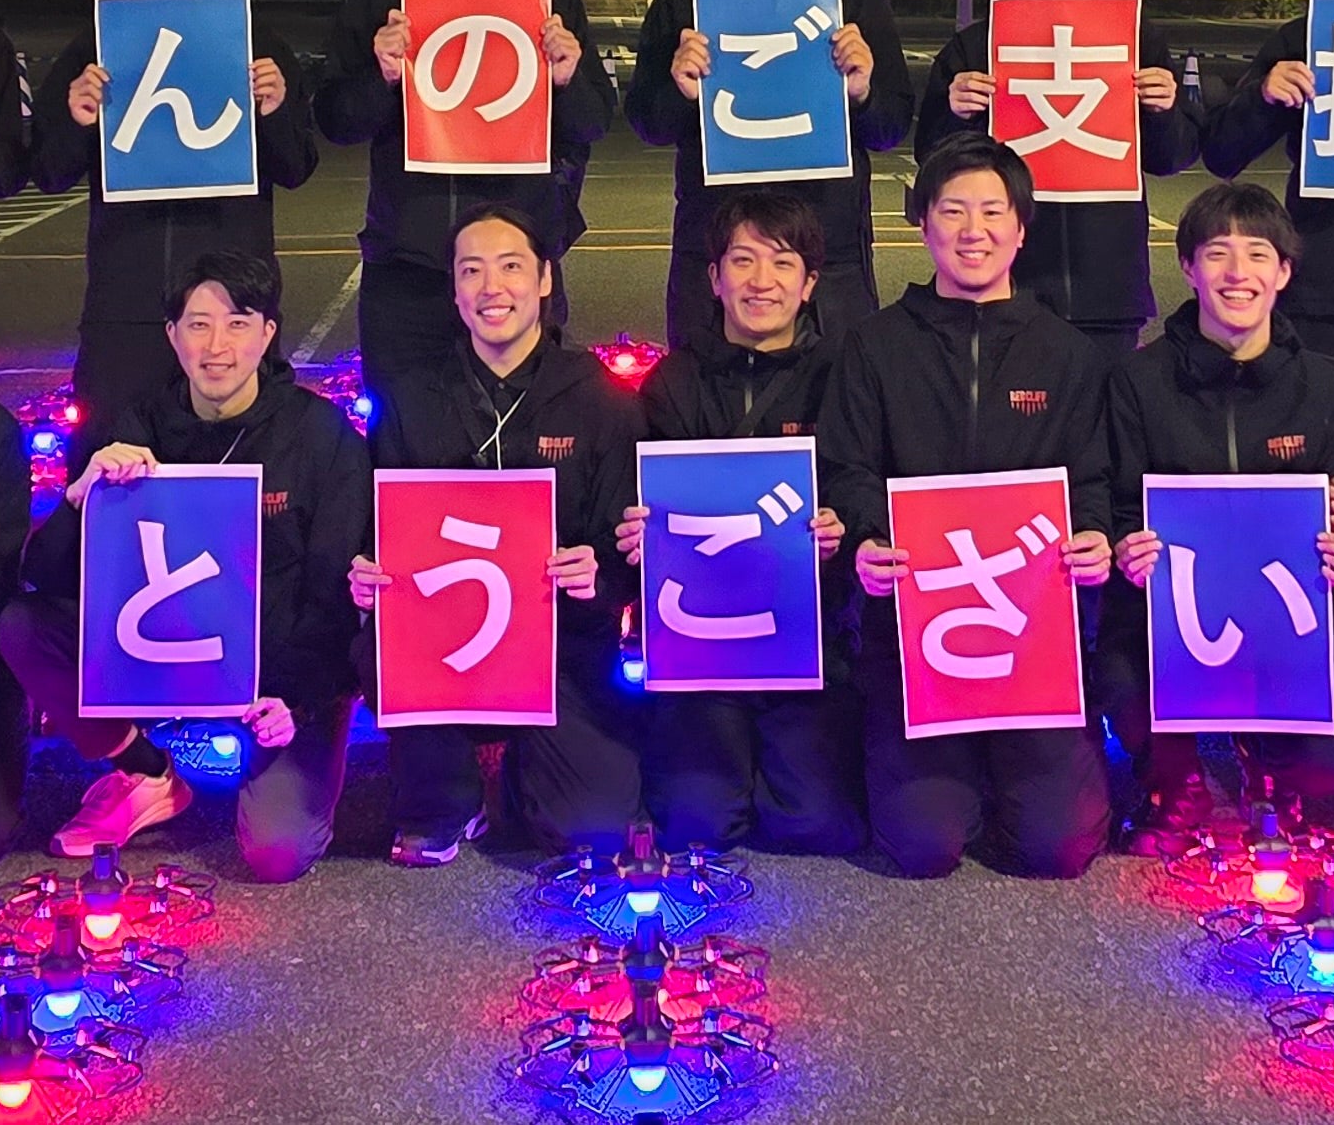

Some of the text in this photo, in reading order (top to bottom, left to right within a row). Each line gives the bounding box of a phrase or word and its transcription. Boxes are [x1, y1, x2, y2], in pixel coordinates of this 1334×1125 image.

[112, 28, 242, 153] ん
[414, 15, 538, 122] の
[713, 5, 832, 139] ご
[998, 25, 1131, 160] 支
[116, 521, 224, 662] と
[412, 515, 512, 672] う
[657, 481, 805, 640] ご
[914, 513, 1061, 679] ざ
[1169, 544, 1318, 667] い
